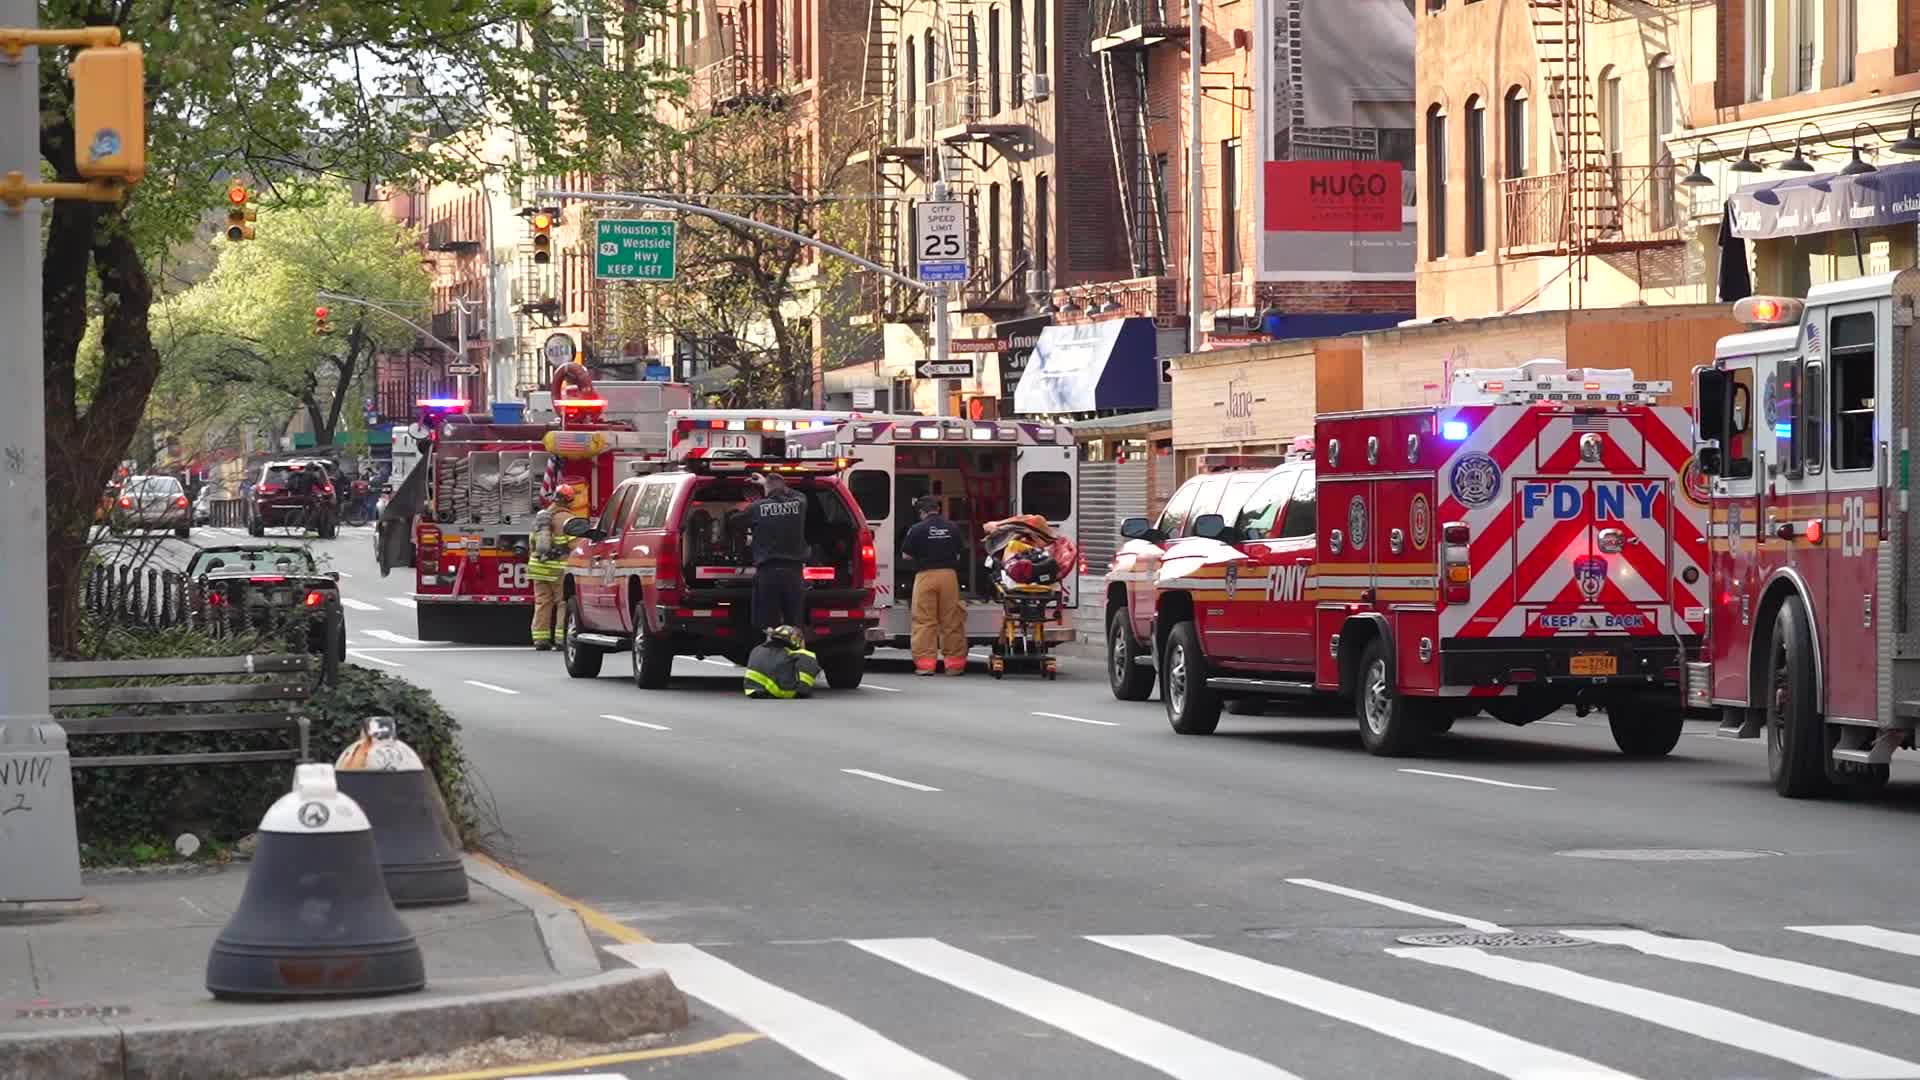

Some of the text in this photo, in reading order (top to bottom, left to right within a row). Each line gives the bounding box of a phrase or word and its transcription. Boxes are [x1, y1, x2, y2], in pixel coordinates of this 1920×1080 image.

[1310, 173, 1387, 197] HUGO
[1850, 201, 1875, 218] dinner
[928, 215, 956, 223] SPEED
[600, 224, 672, 236] W Houston St
[931, 224, 953, 232] LIMIT
[603, 244, 616, 253] 9A
[623, 238, 672, 249] Westside
[925, 234, 960, 256] 25
[634, 251, 659, 263] Hwy
[607, 264, 663, 276] KEEP LEFT
[952, 341, 1008, 352] Thompson St
[923, 364, 967, 374] ONE WAY
[1226, 380, 1253, 419] Jane
[760, 500, 801, 517] FDNY
[1522, 484, 1661, 520] FDNY
[1842, 496, 1864, 557] 28
[498, 562, 529, 589] 26
[1265, 564, 1308, 601] FDNY
[1540, 615, 1644, 628] KEEP BACK
